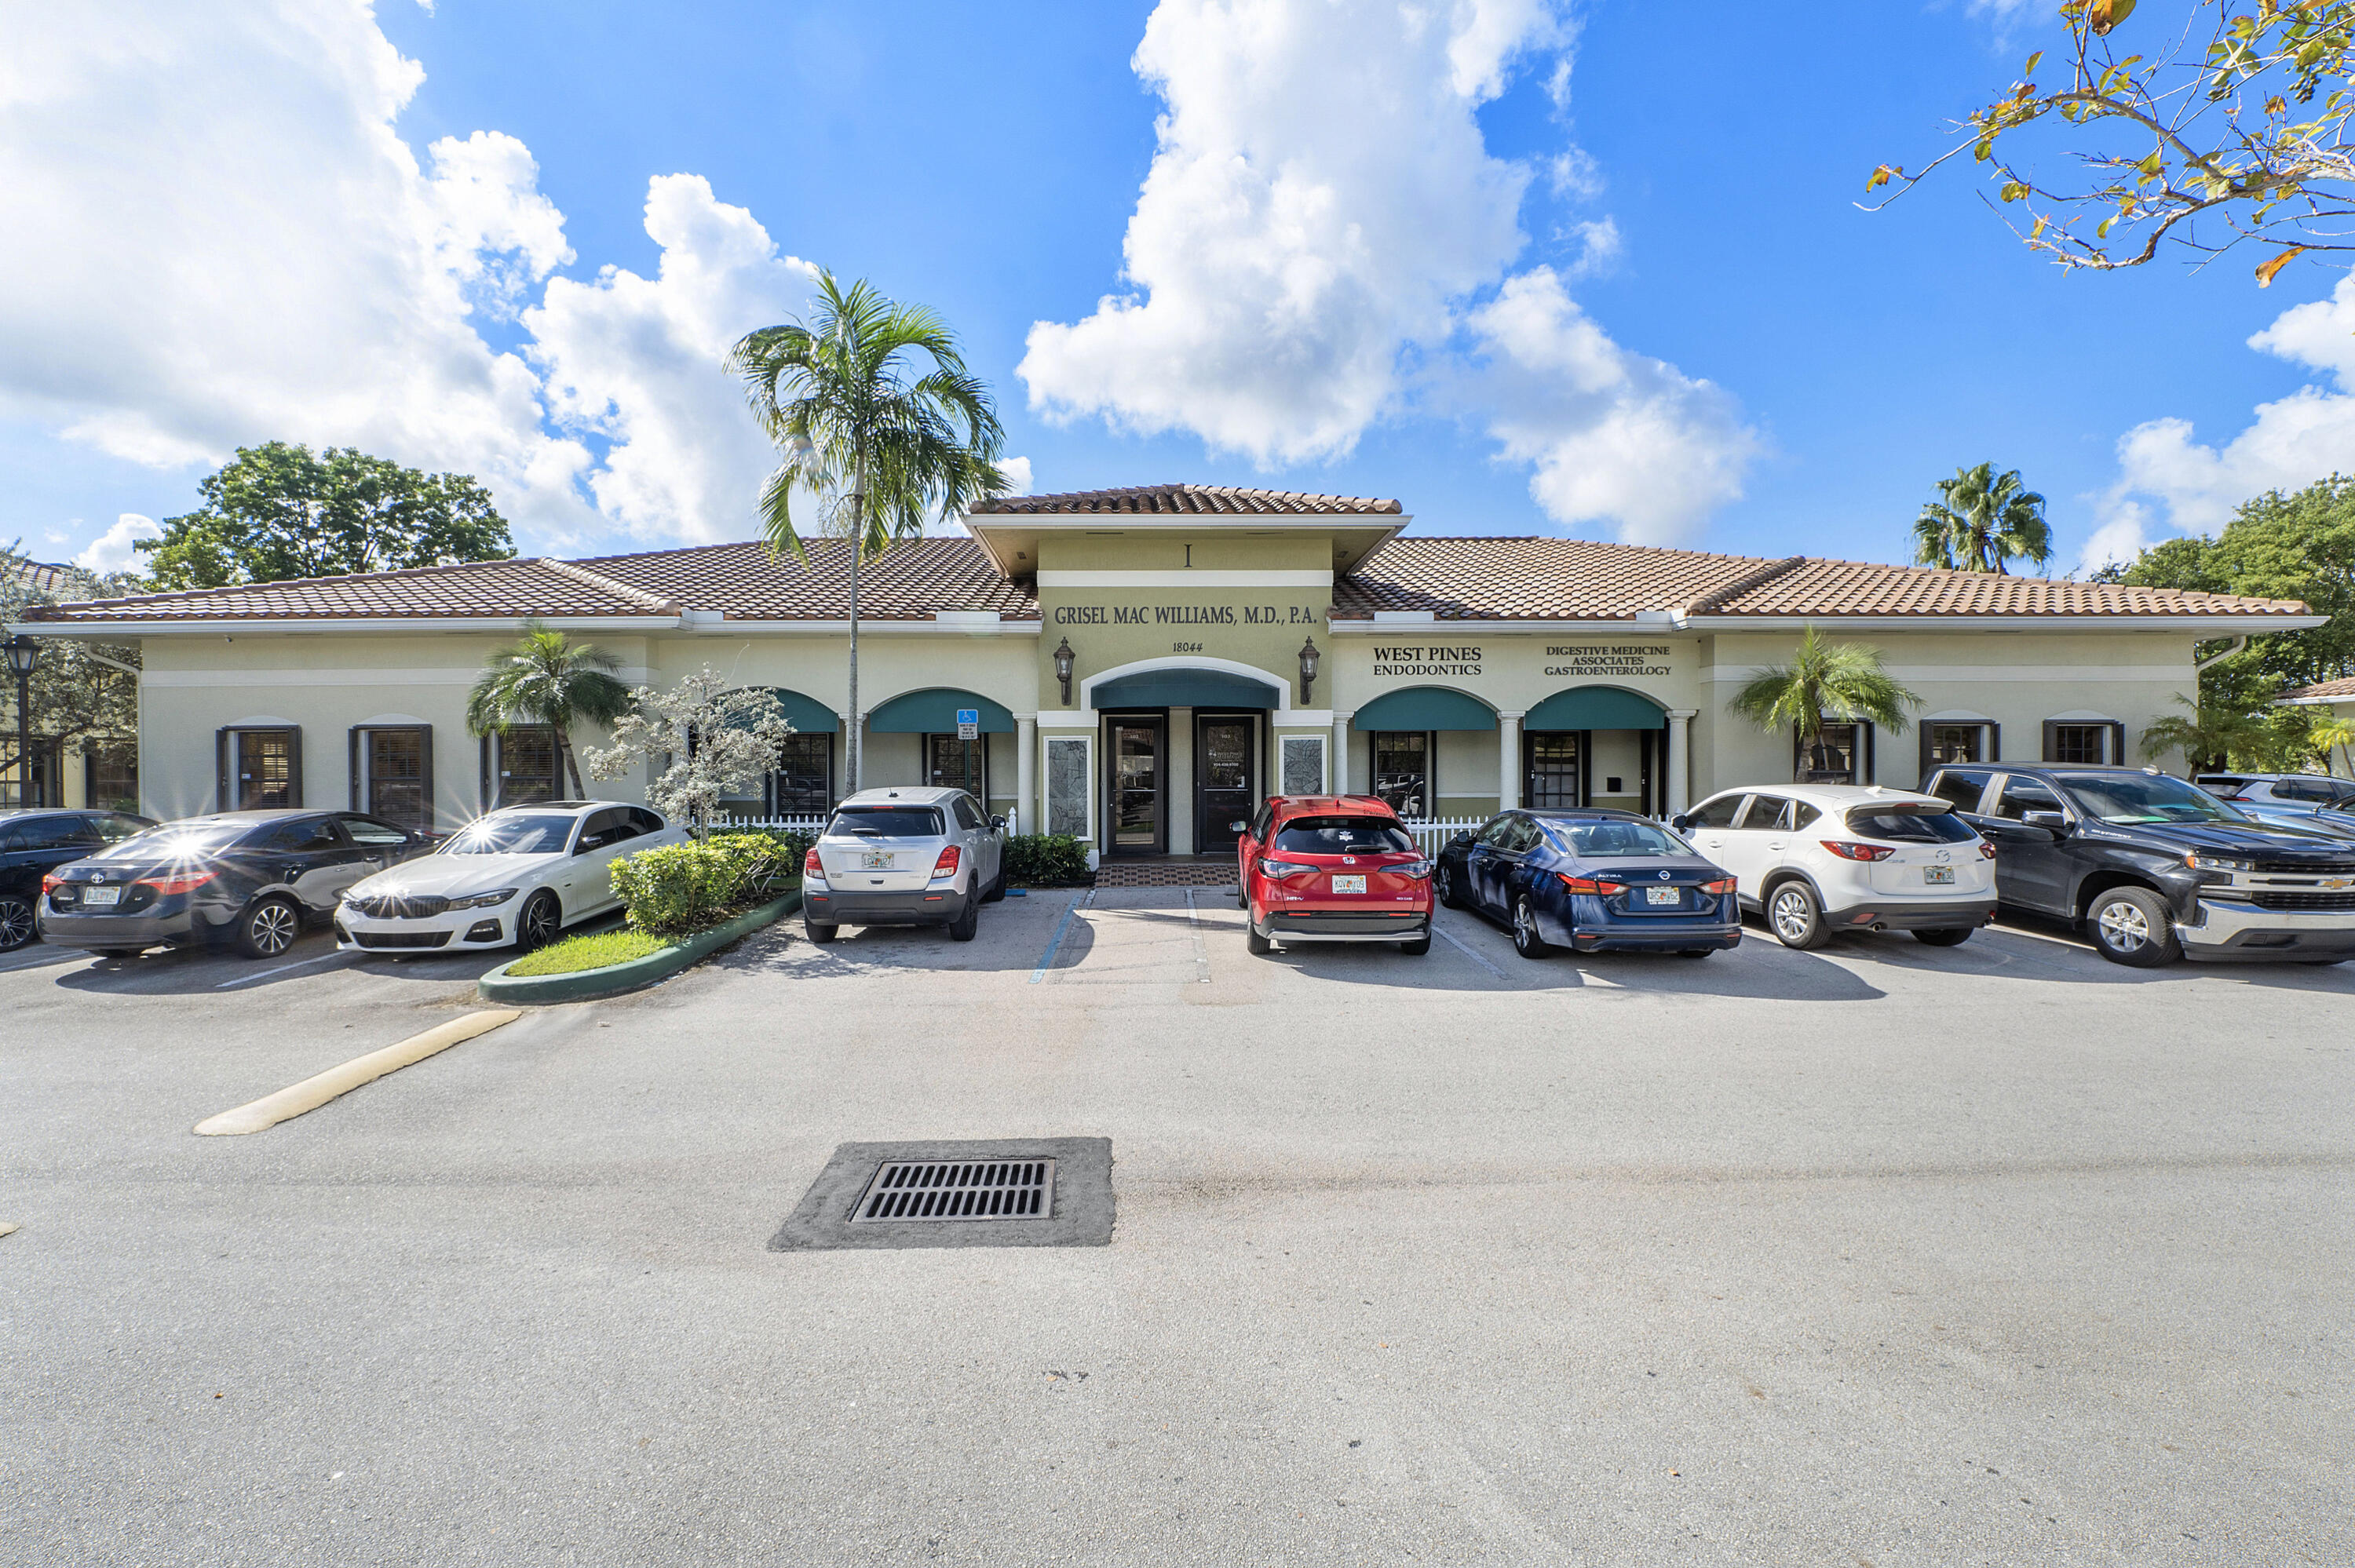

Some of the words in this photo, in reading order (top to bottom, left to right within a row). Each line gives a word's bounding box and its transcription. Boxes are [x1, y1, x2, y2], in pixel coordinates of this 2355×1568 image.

[1054, 607, 1108, 625] GRISEL
[1113, 607, 1149, 625] MAC
[1155, 607, 1238, 626] WILLIAMS,
[1243, 607, 1285, 626] M.D.,
[1289, 607, 1317, 624] P.A.
[1173, 642, 1203, 652] 18044
[1546, 646, 1609, 655] DIGESTIVE
[1611, 646, 1670, 655] MEDICINE
[1373, 647, 1425, 661] WEST
[1428, 647, 1482, 661] PINES
[1572, 656, 1645, 665] ASSOCIATES
[1373, 664, 1482, 675] ENDODONTICS
[1544, 666, 1671, 676] GASTROENTEROLOGY
